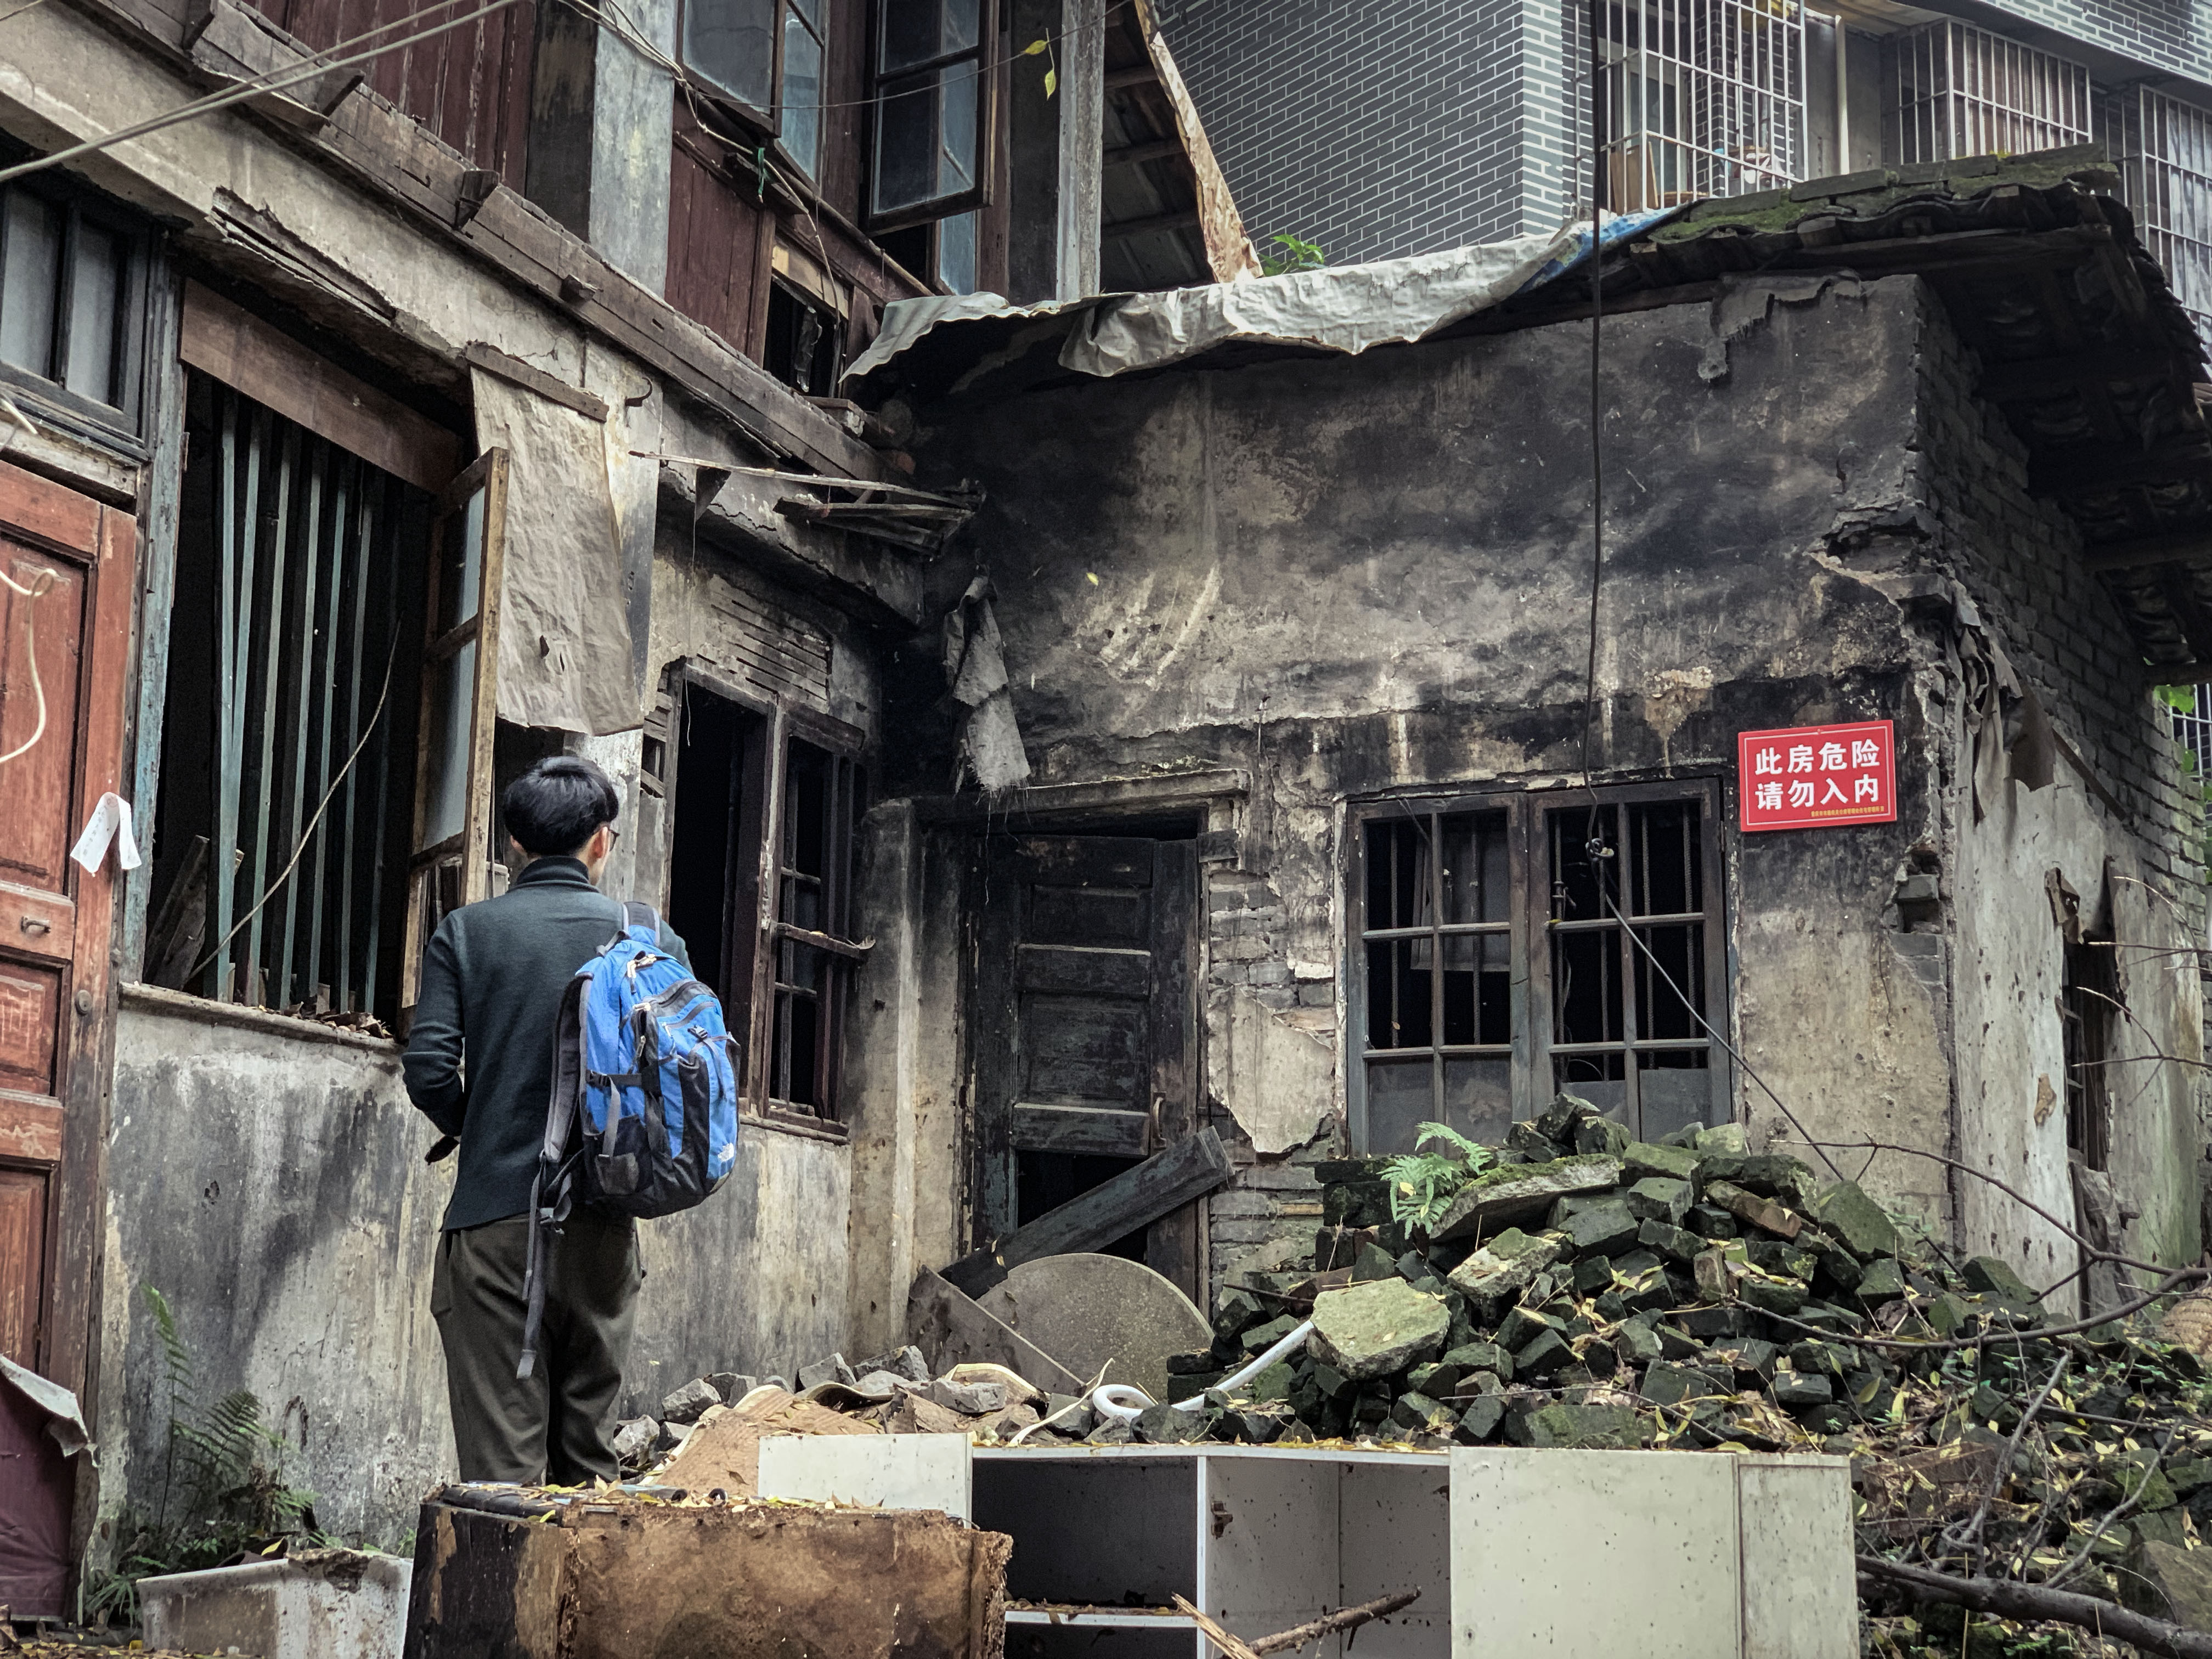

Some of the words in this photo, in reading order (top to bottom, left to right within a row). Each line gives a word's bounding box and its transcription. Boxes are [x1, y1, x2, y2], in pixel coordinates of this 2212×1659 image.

[1755, 738, 1880, 775] 此房危险
[1754, 774, 1879, 810] 请勿入内
